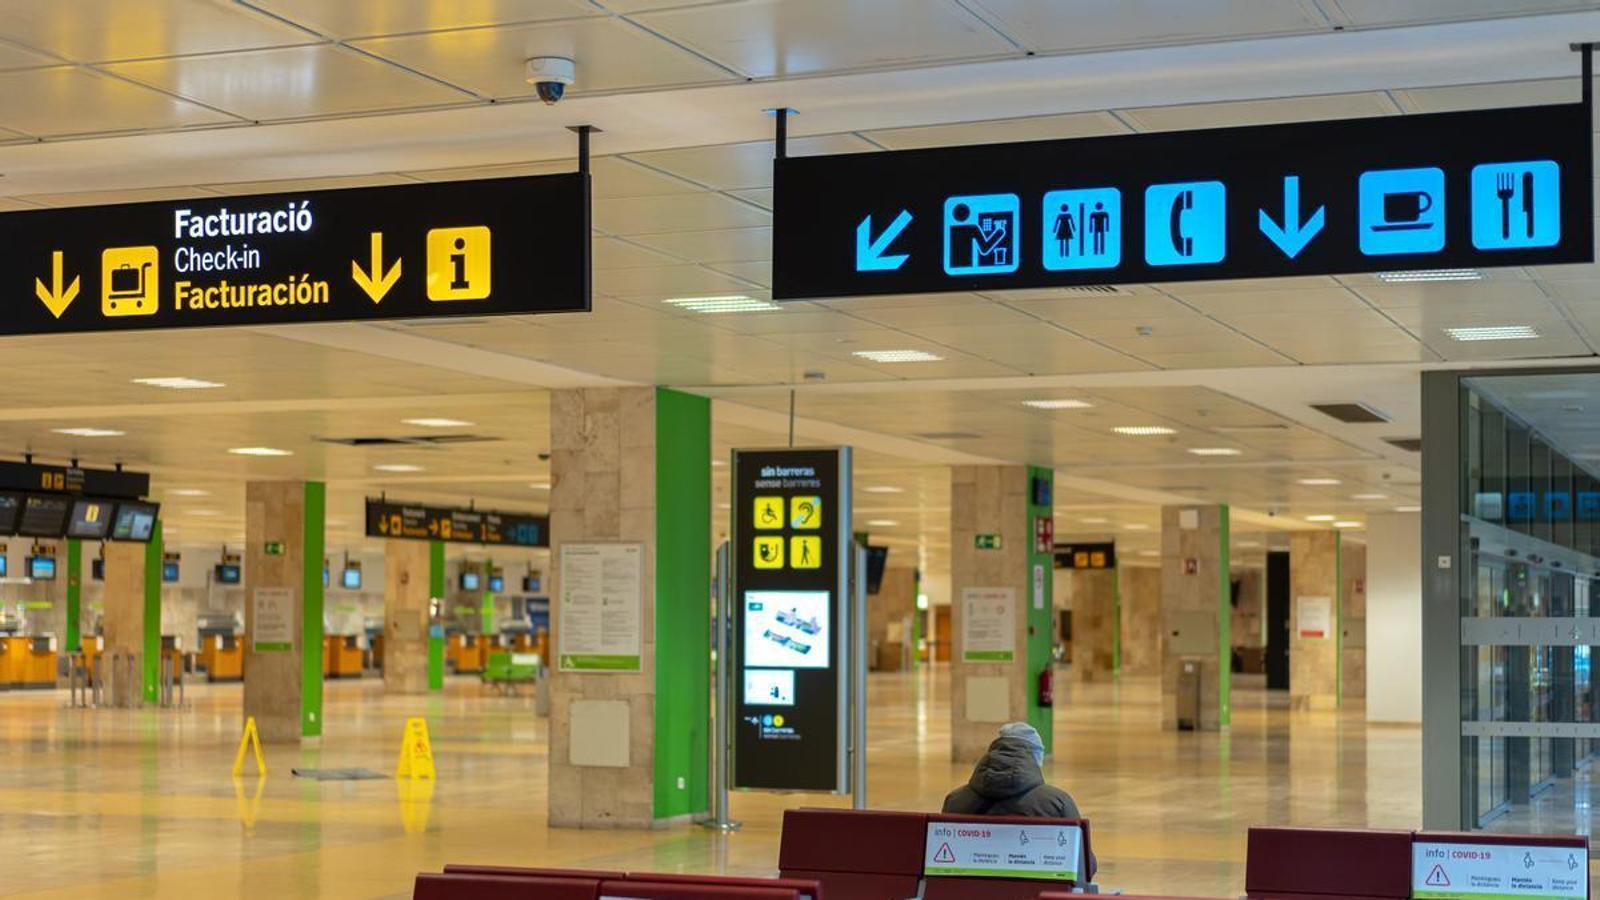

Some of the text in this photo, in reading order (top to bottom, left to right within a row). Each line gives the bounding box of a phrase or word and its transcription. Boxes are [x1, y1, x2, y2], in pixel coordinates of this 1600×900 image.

[175, 201, 312, 239] Facturació
[174, 243, 261, 273] Check-in
[174, 273, 329, 310] Facturación
[934, 828, 992, 838] info COVID-19
[1425, 849, 1491, 860] info COVID-19
